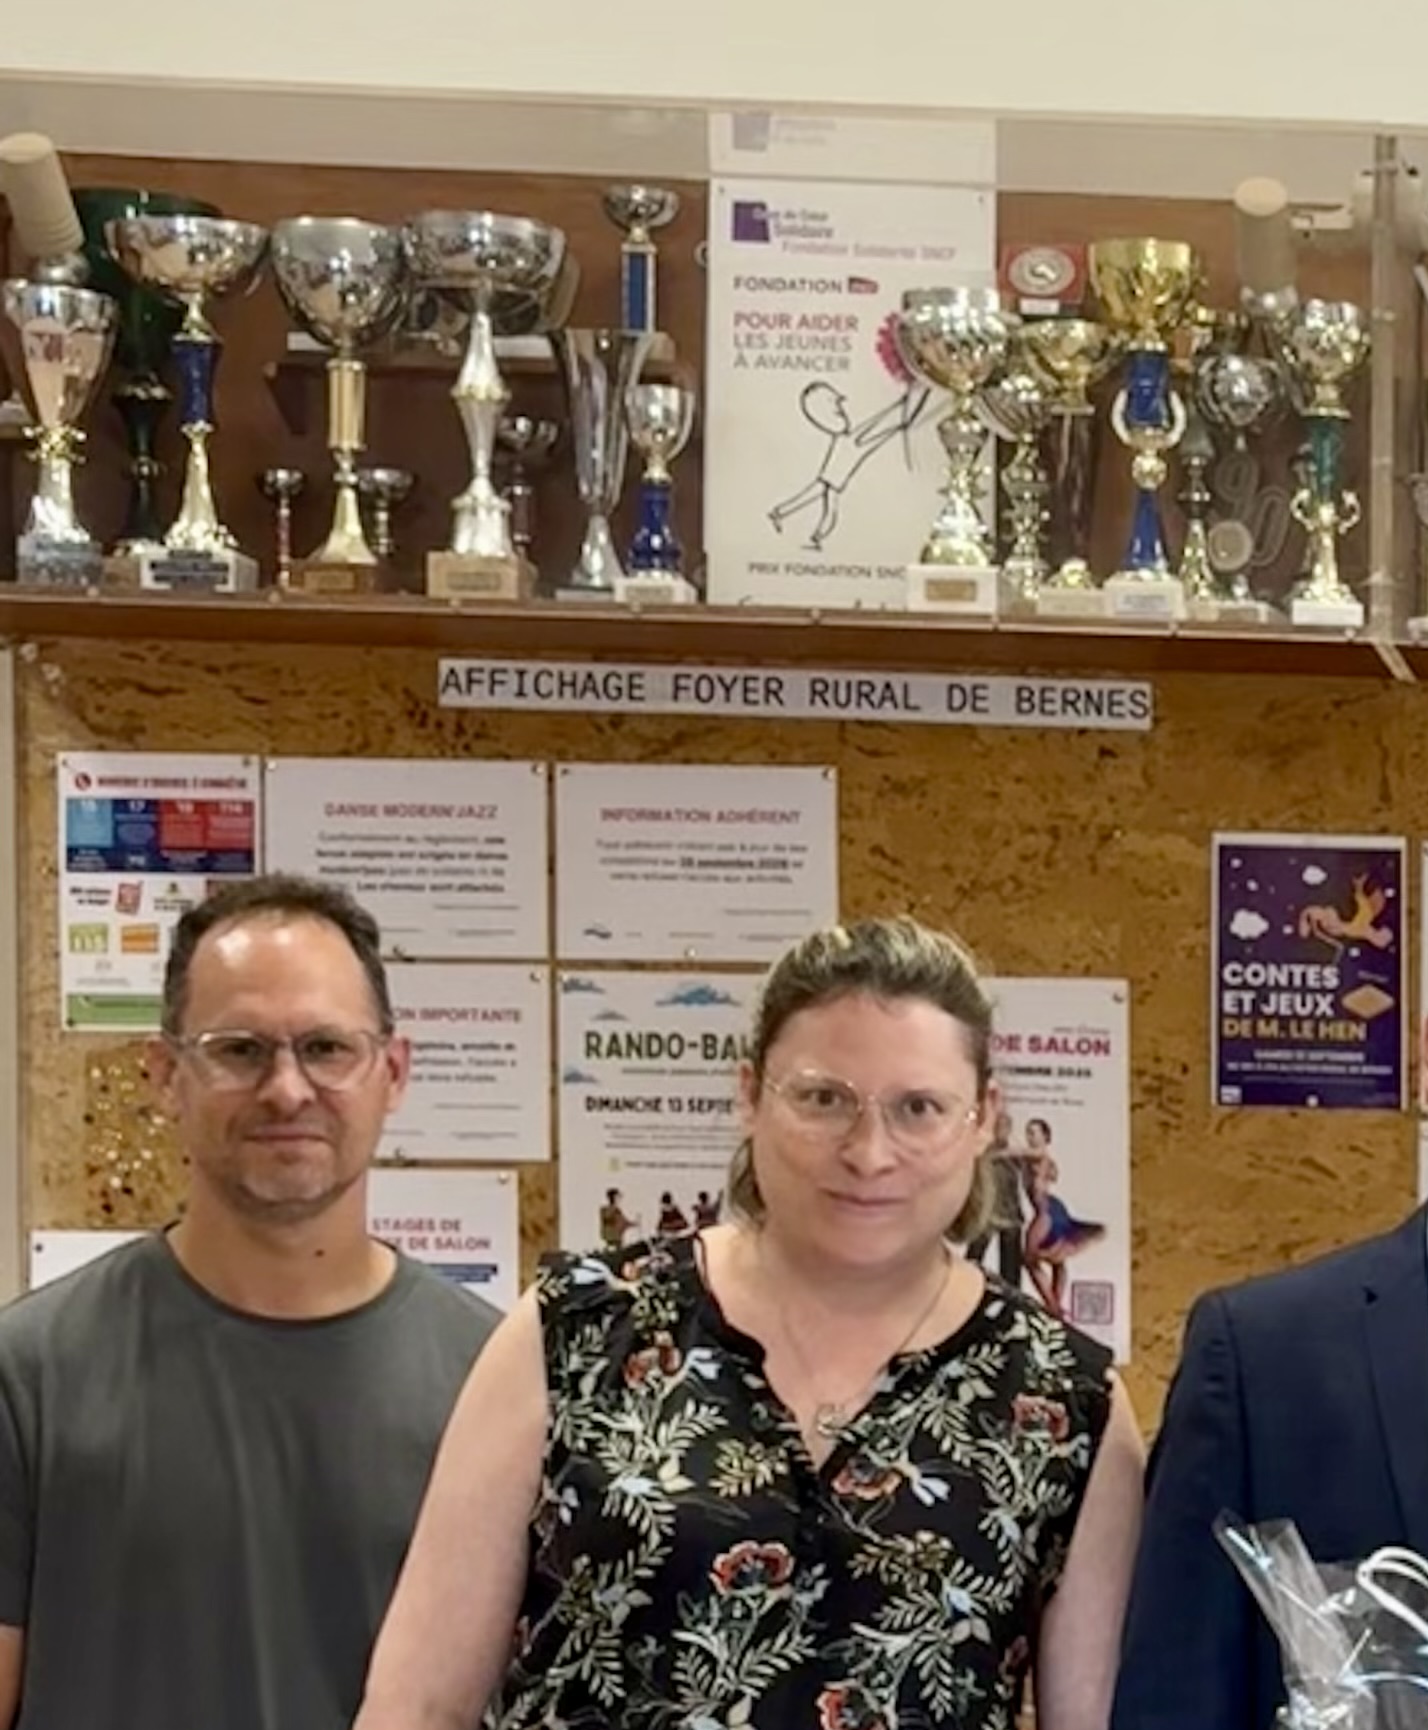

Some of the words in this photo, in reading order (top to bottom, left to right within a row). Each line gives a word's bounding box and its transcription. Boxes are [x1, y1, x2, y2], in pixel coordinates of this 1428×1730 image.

[733, 276, 842, 293] FONDATION
[734, 312, 791, 330] POUR
[797, 314, 859, 332] AIDER
[734, 333, 769, 349] LES
[774, 334, 852, 352] JEUNES
[754, 353, 849, 371] AVANCER
[785, 563, 871, 578] FONDATION
[877, 565, 907, 578] SNC
[441, 667, 645, 701] AFFICHAGE
[672, 673, 784, 707] FOYER
[809, 677, 921, 711] RURAL
[946, 683, 989, 713] DE
[1015, 685, 1150, 719] BERNES
[324, 803, 378, 818] DANSE
[601, 807, 711, 824] INFORMATION
[717, 806, 802, 825] ADHÉRENT
[1222, 962, 1340, 988] CONTES
[1222, 991, 1256, 1015] ET
[1260, 992, 1335, 1017] JEUX
[420, 1007, 522, 1024] IMPORTANTE
[1222, 1018, 1249, 1038] DE
[1255, 1019, 1286, 1039] M.
[1290, 1020, 1315, 1040] LE
[1028, 1034, 1111, 1056] SALON
[585, 1096, 662, 1114] DIMANCHE
[372, 1217, 435, 1232] STAGES
[440, 1218, 461, 1232] DE
[408, 1236, 429, 1250] DE
[435, 1235, 491, 1251] SALON
